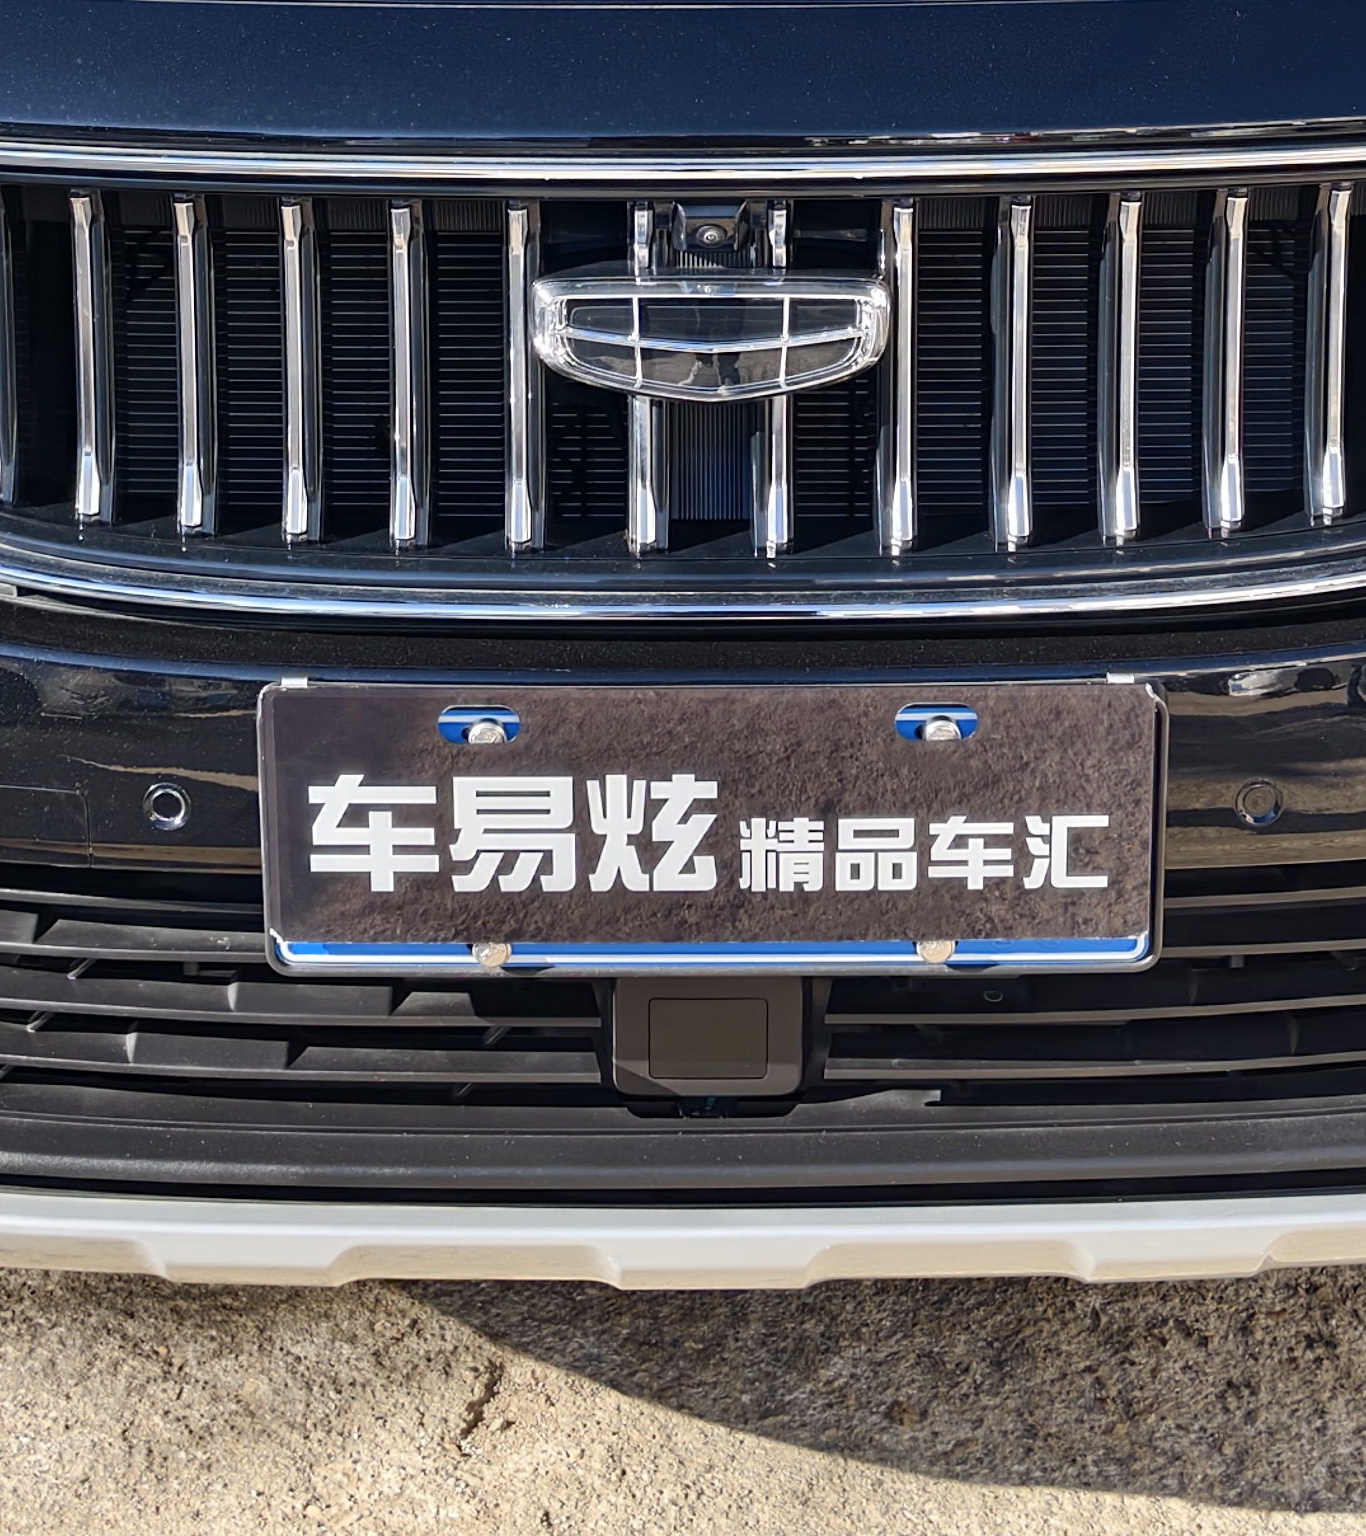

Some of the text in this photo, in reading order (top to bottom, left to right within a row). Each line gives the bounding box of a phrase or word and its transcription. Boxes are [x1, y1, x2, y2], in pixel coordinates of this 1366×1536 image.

[307, 773, 1110, 893] 车易炫 精品车汇
